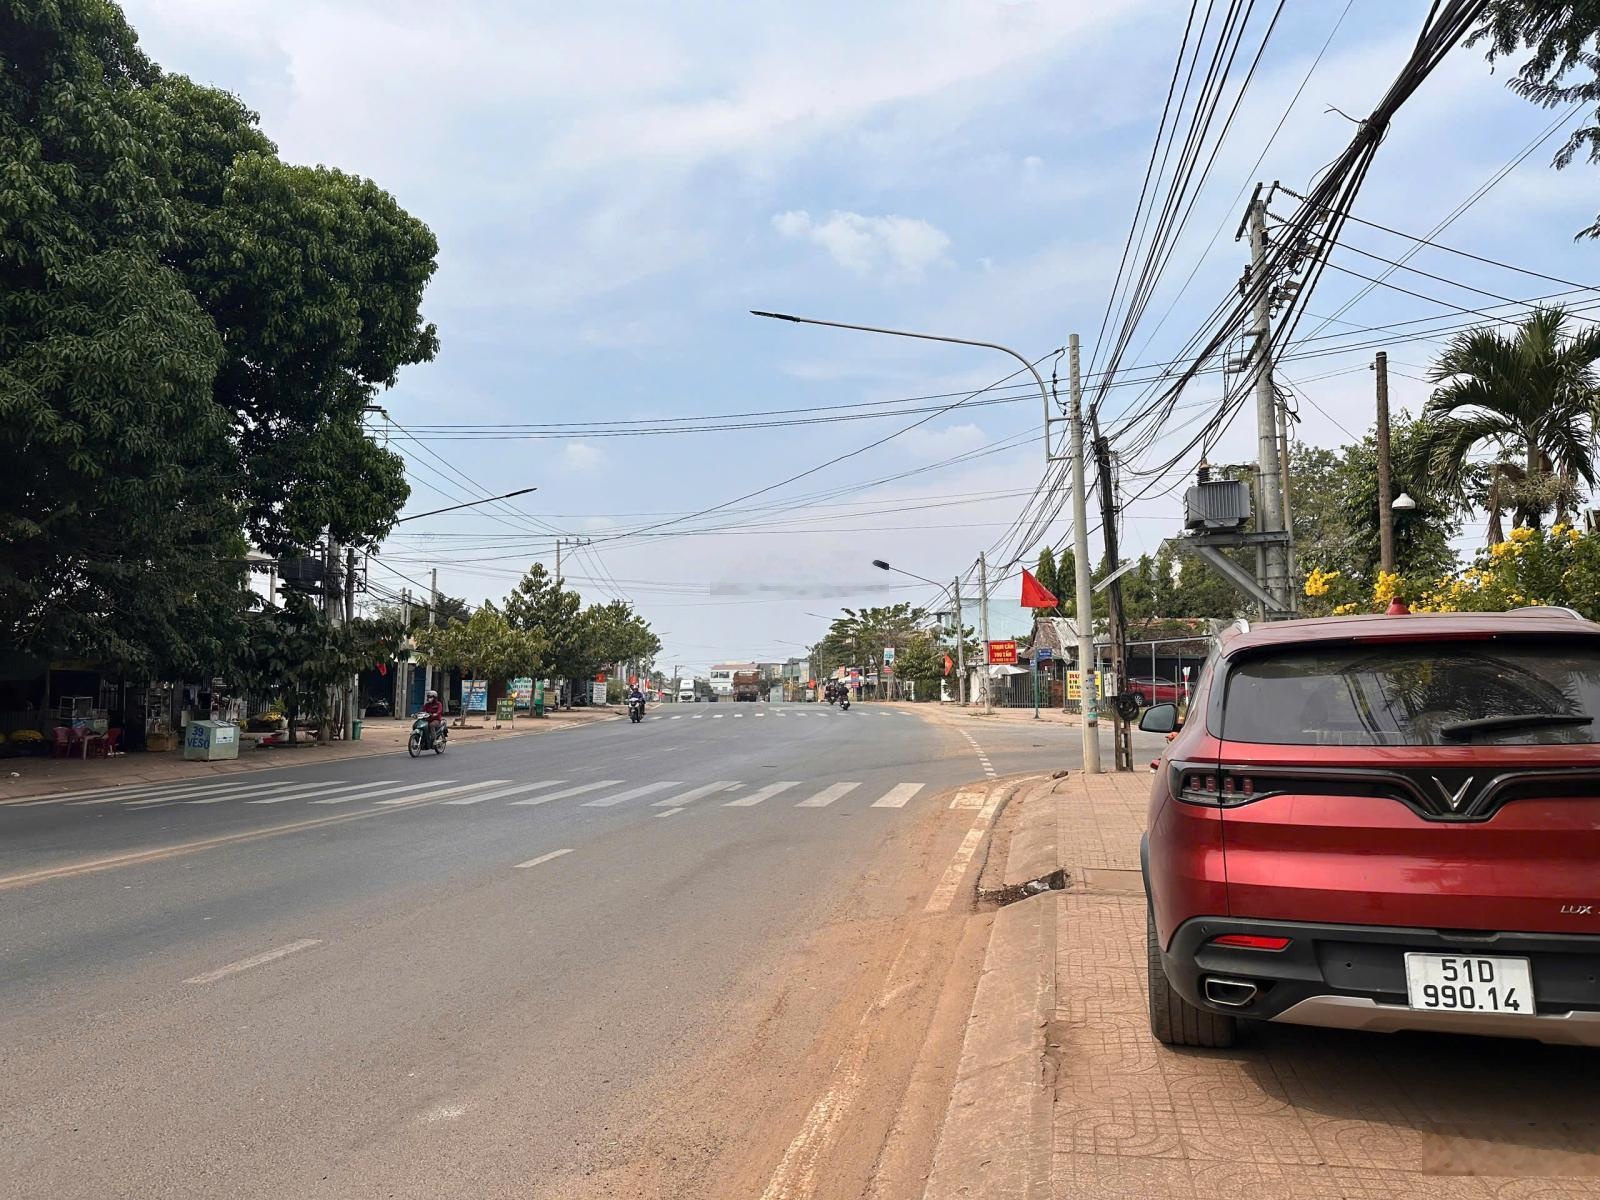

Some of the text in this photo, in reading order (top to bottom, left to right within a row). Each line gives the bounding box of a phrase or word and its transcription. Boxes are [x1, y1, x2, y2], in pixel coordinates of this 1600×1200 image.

[191, 725, 204, 737] 39
[1560, 905, 1592, 914] LUX
[1441, 958, 1495, 983] 51D
[1423, 984, 1520, 1011] 990.14
